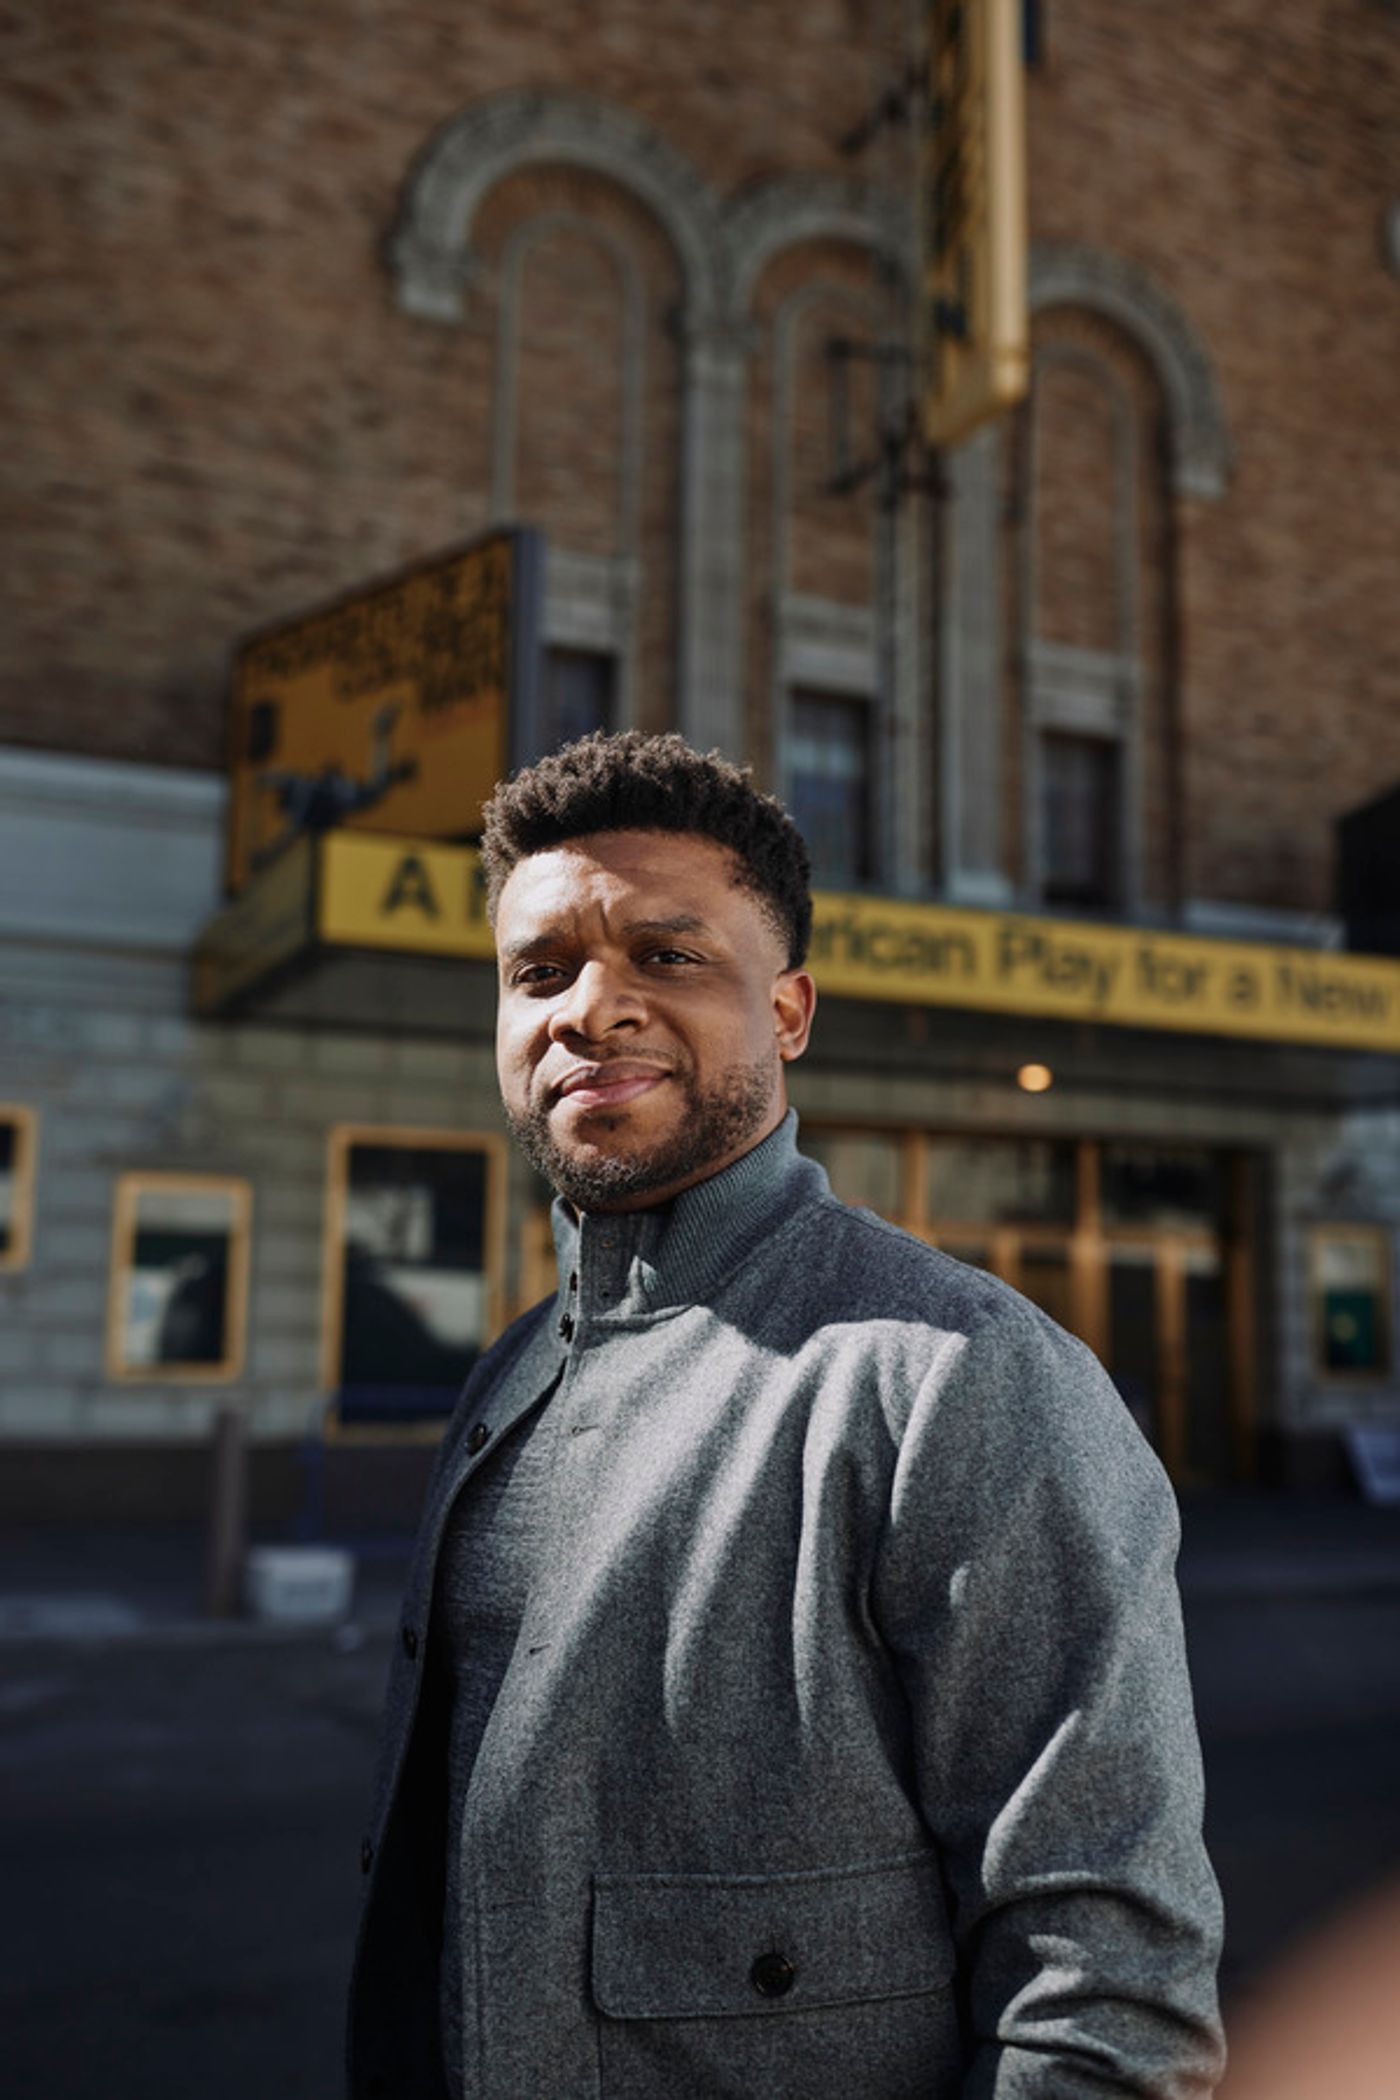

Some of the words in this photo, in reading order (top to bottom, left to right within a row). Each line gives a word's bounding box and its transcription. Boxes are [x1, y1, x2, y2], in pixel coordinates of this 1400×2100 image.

[379, 854, 443, 925] A
[811, 905, 977, 981] rican
[998, 919, 1121, 1016] Play
[1136, 939, 1208, 1000] for
[1227, 962, 1260, 1012] a
